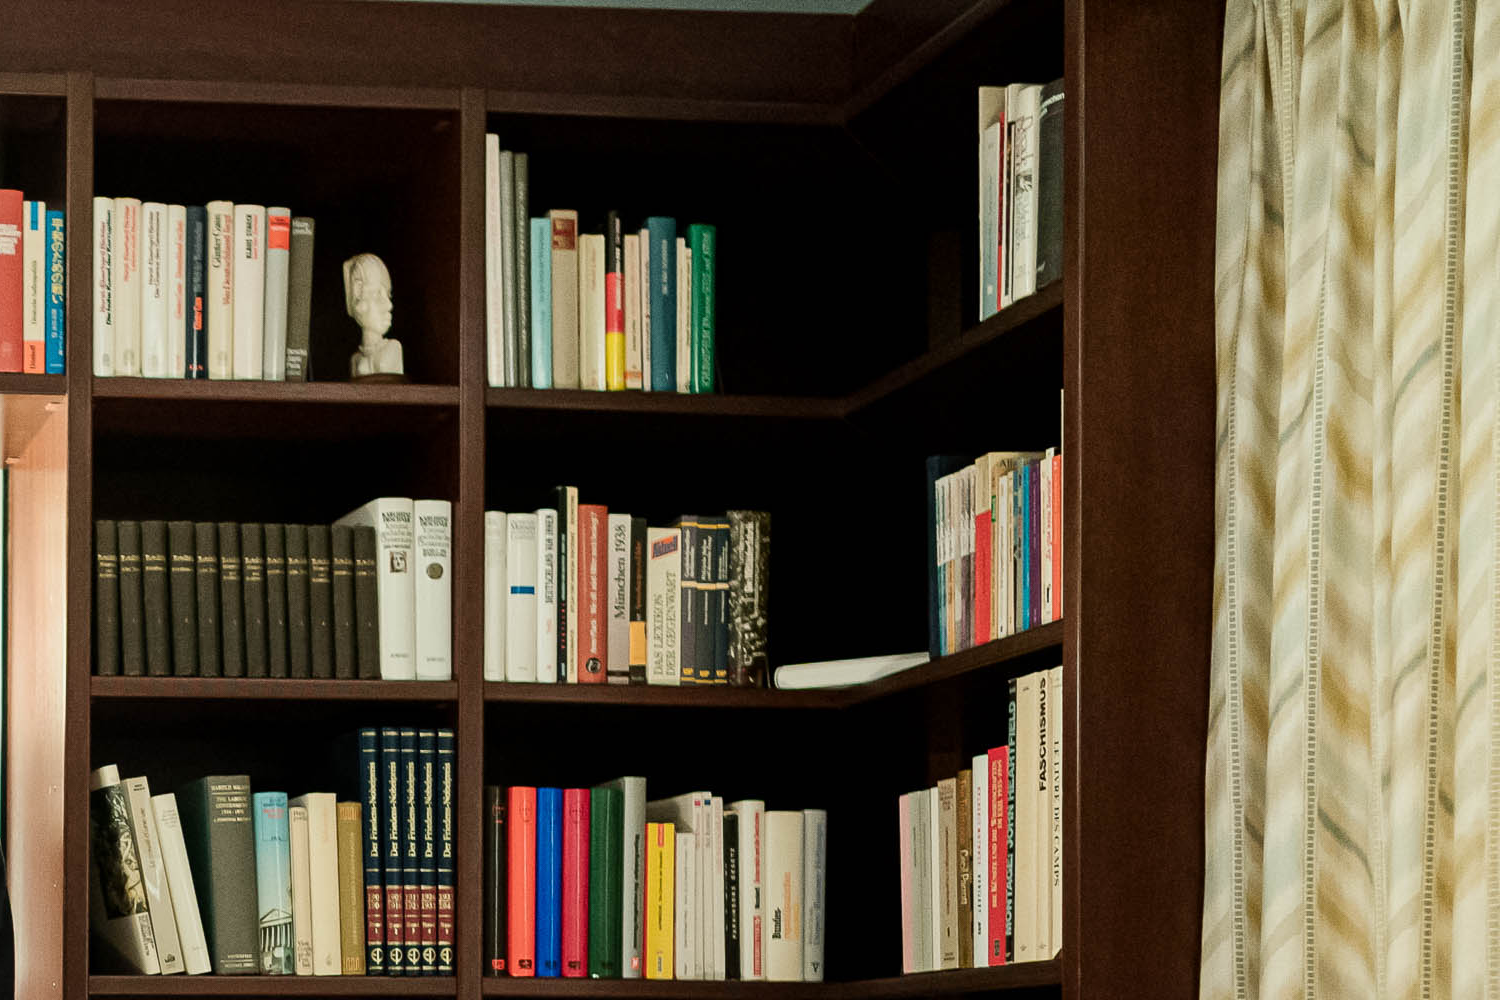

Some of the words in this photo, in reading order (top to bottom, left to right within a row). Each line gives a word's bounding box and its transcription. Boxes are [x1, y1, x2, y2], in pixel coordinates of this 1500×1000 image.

[613, 557, 626, 619] München
[653, 652, 663, 675] DAS
[1039, 677, 1047, 792] FASCHISMUS
[1007, 700, 1016, 801] HEARTFIELD
[1007, 803, 1015, 848] JOHN
[371, 841, 379, 857] Der
[390, 841, 399, 857] Der
[408, 842, 416, 857] Der
[424, 842, 433, 858] Der
[443, 842, 452, 858] Der
